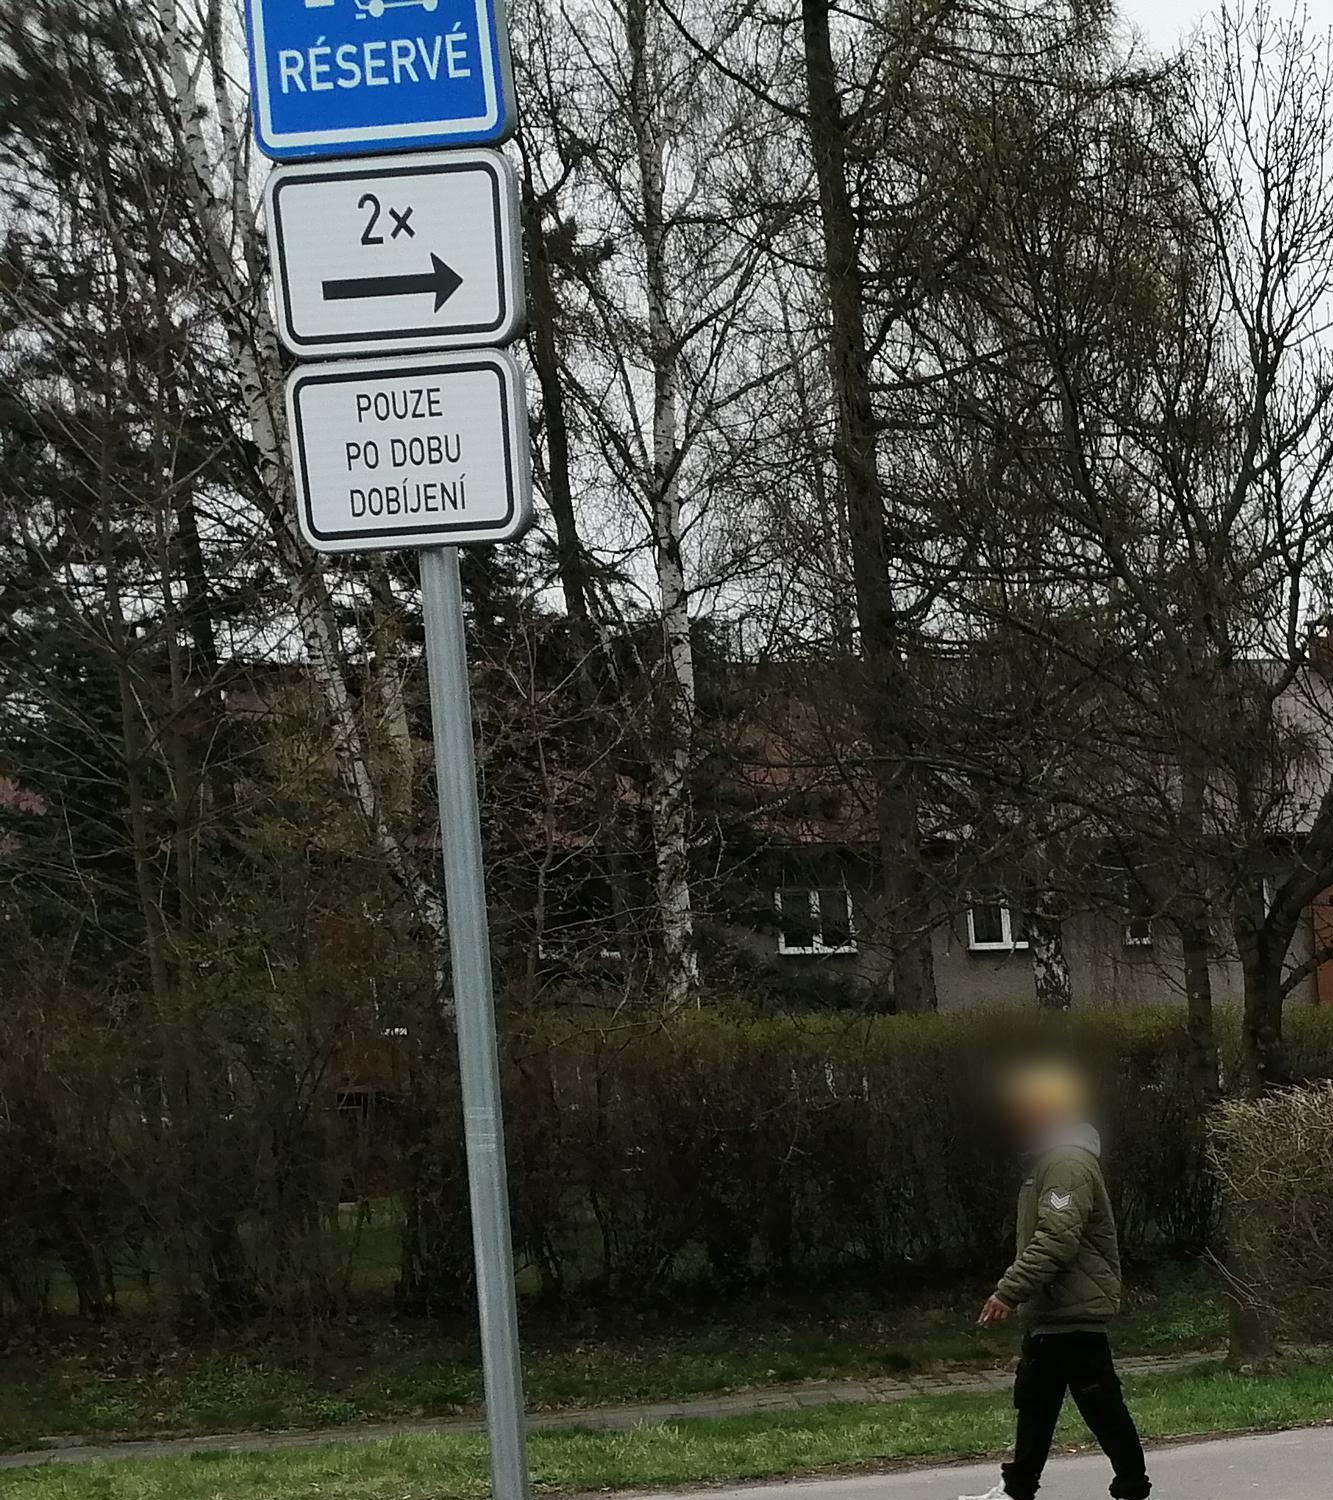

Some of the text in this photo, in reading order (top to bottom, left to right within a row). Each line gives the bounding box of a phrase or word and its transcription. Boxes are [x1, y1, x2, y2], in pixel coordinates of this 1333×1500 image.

[279, 21, 471, 94] RÉSERVÉ
[356, 387, 443, 423] POUZE
[346, 434, 461, 471] PO DOBU
[350, 473, 466, 518] DOBÍJENÍ
